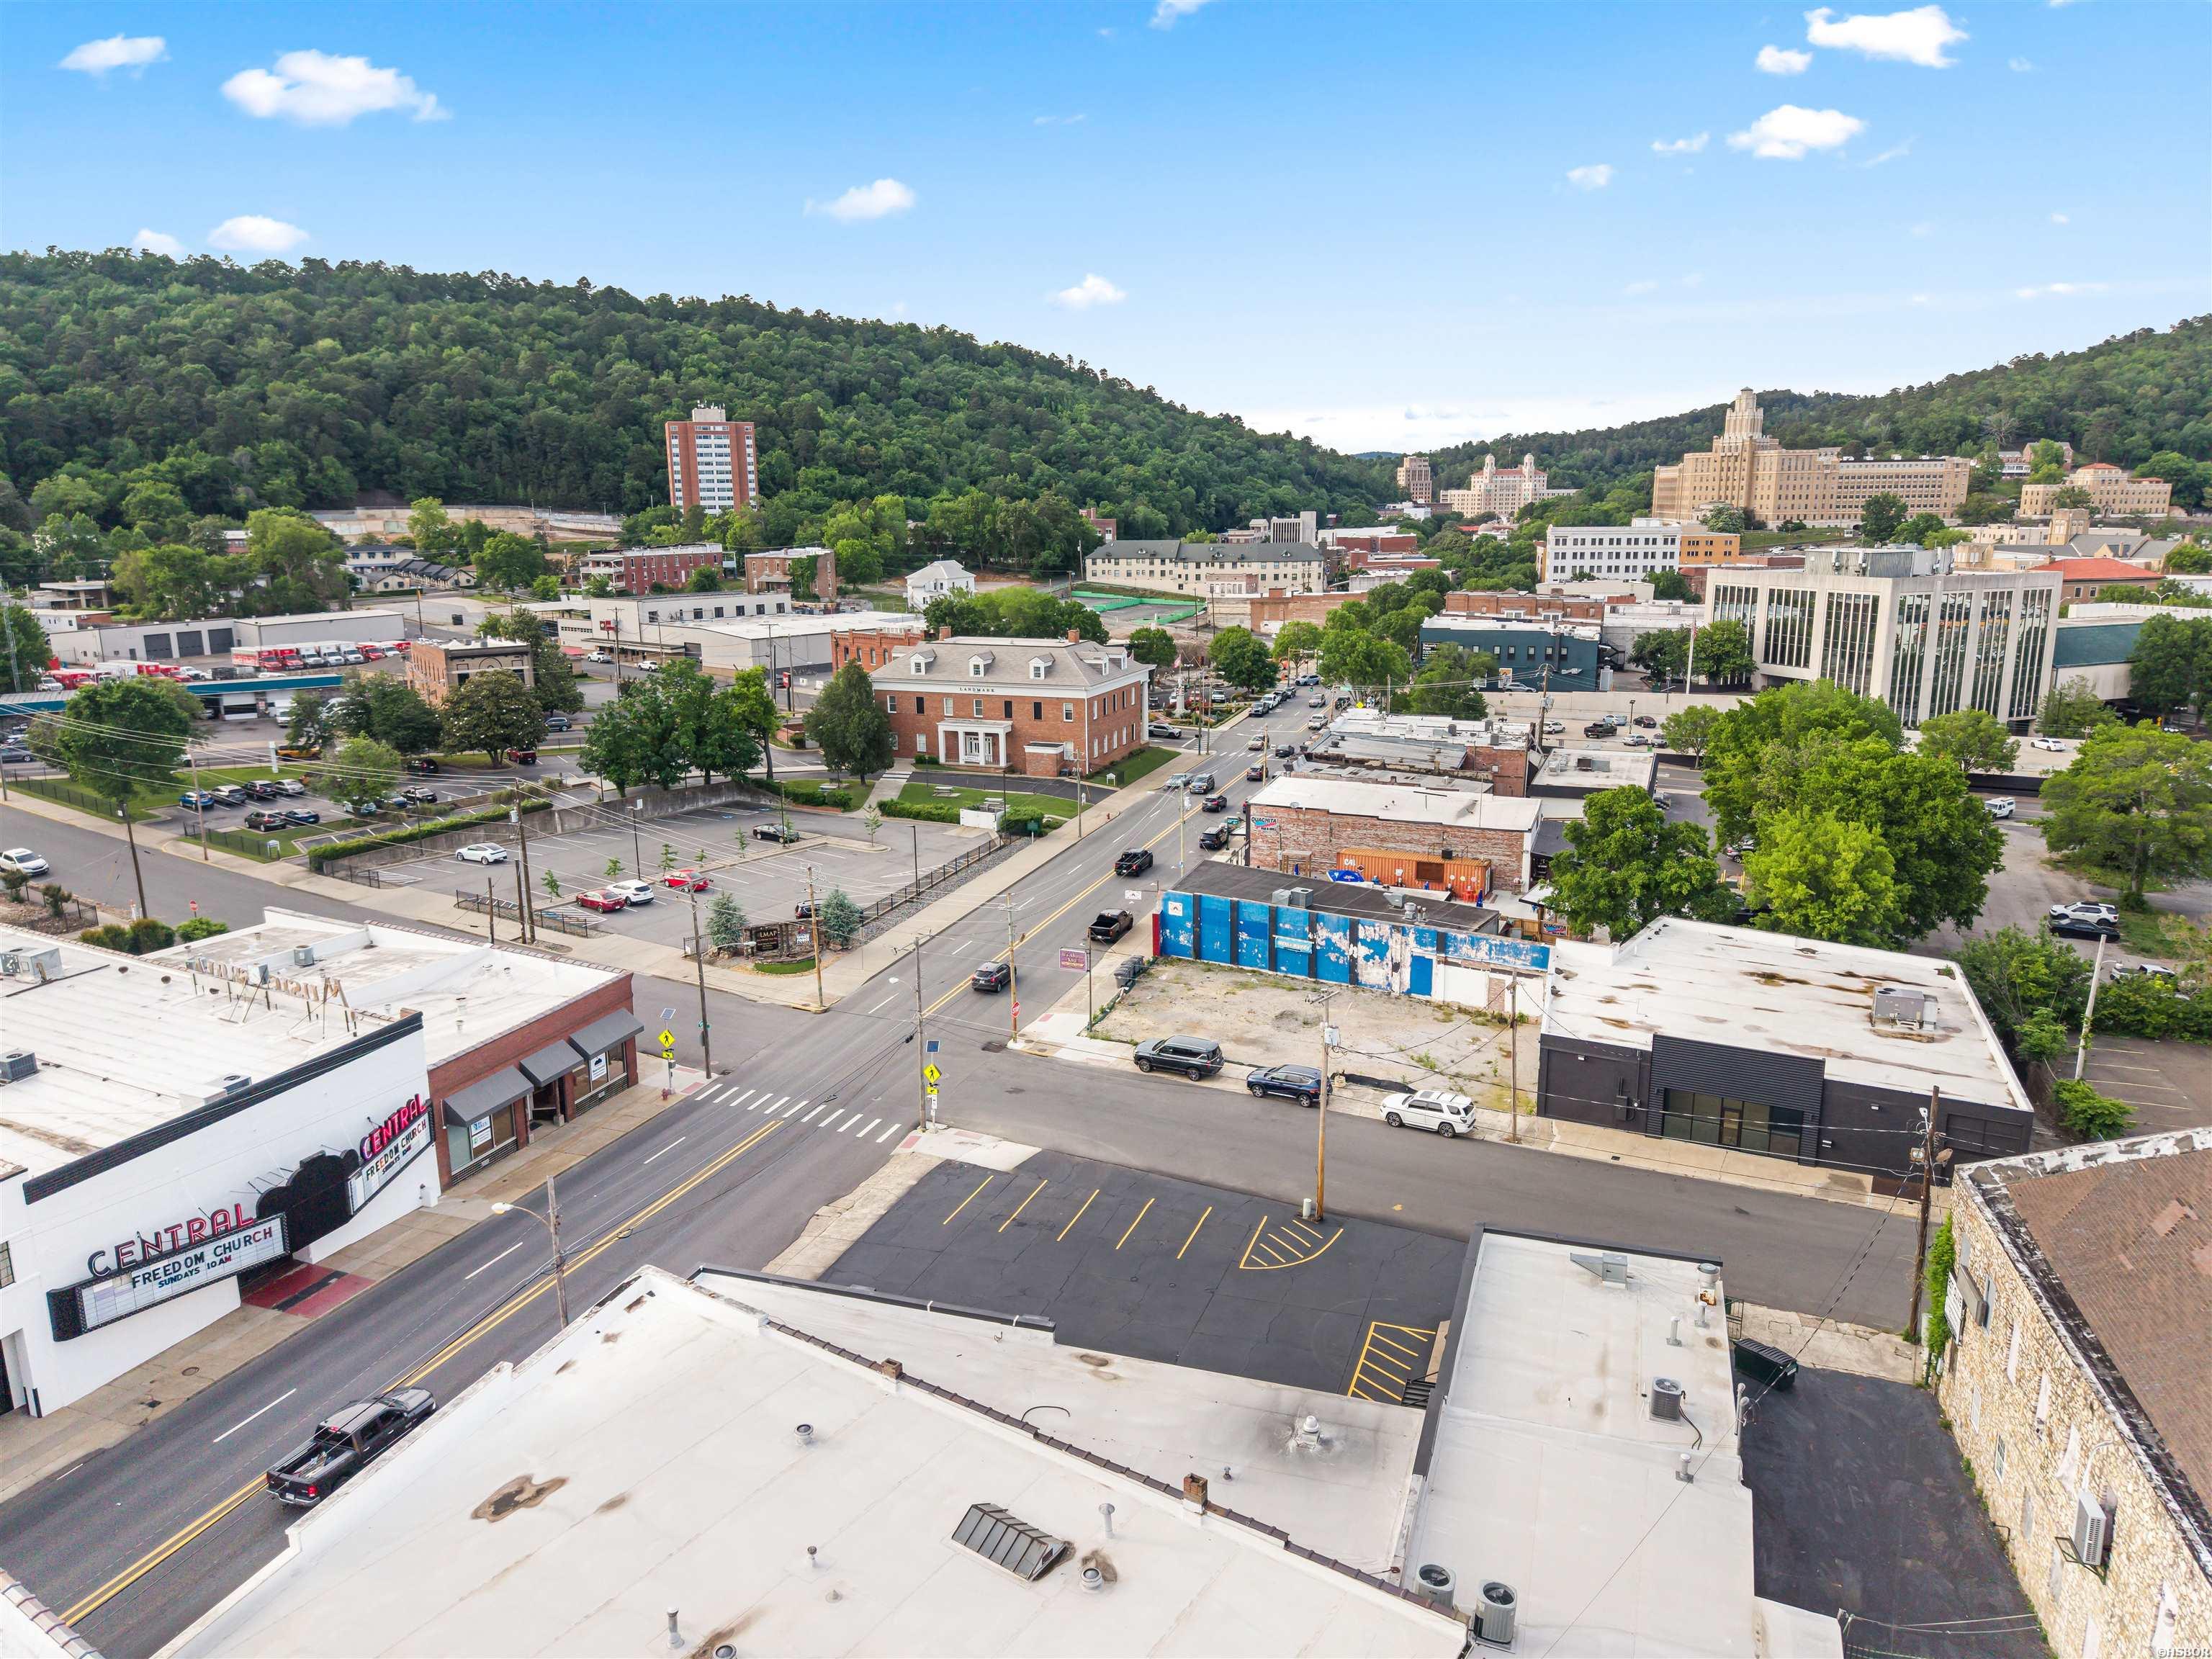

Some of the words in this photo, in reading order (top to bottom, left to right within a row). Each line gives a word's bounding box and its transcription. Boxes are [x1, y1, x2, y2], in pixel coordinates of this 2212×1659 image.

[360, 1094, 427, 1161] CENTRAL
[366, 1143, 400, 1181] FREEDOM
[400, 1119, 426, 1148] CHURCH
[88, 1202, 256, 1278] CENTRAL
[132, 1251, 205, 1288] FREEDOM
[213, 1226, 272, 1257] CHURCH
[158, 1267, 200, 1288] SUNDAYS
